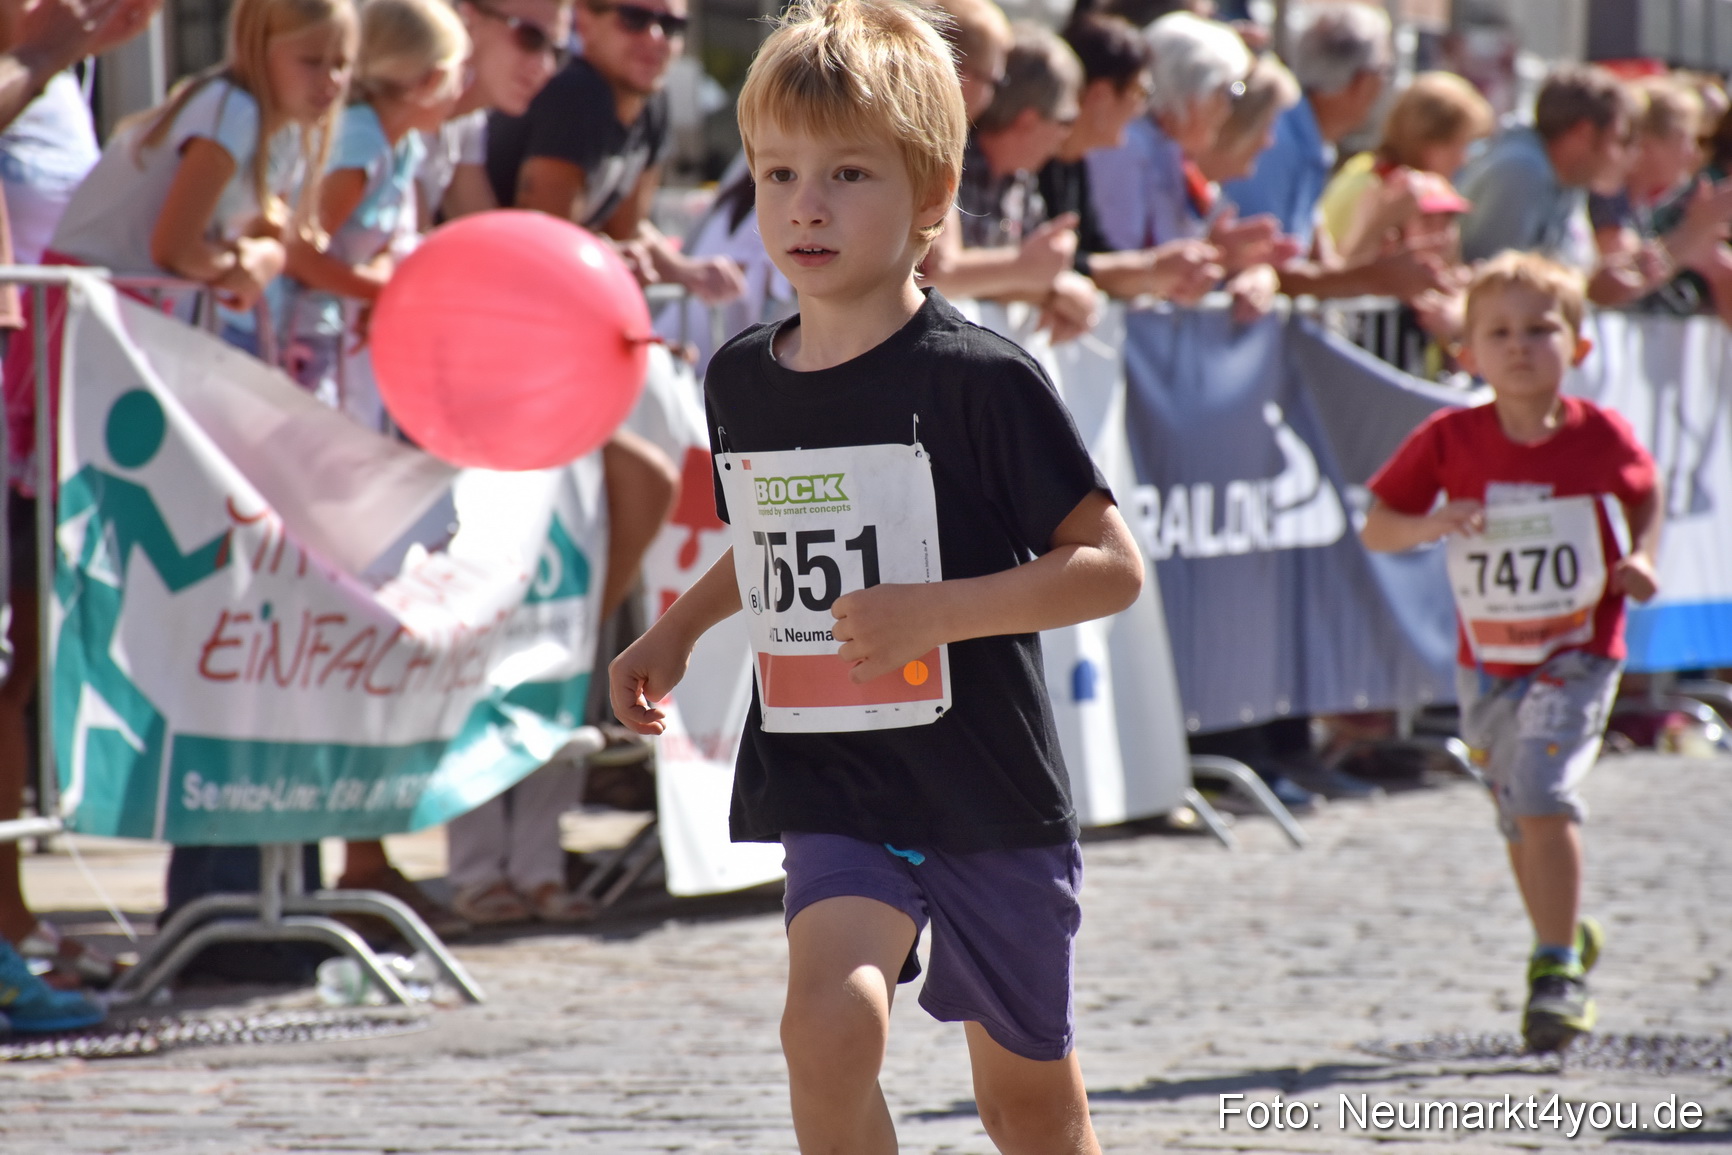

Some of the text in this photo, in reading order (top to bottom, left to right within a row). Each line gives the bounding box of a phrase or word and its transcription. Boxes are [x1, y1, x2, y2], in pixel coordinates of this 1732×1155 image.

[754, 473, 849, 505] BOCK
[783, 506, 808, 516] smart
[809, 503, 852, 515] concepts
[752, 525, 881, 613] 7551
[1467, 544, 1579, 595] 7470
[784, 627, 835, 643] Neuma
